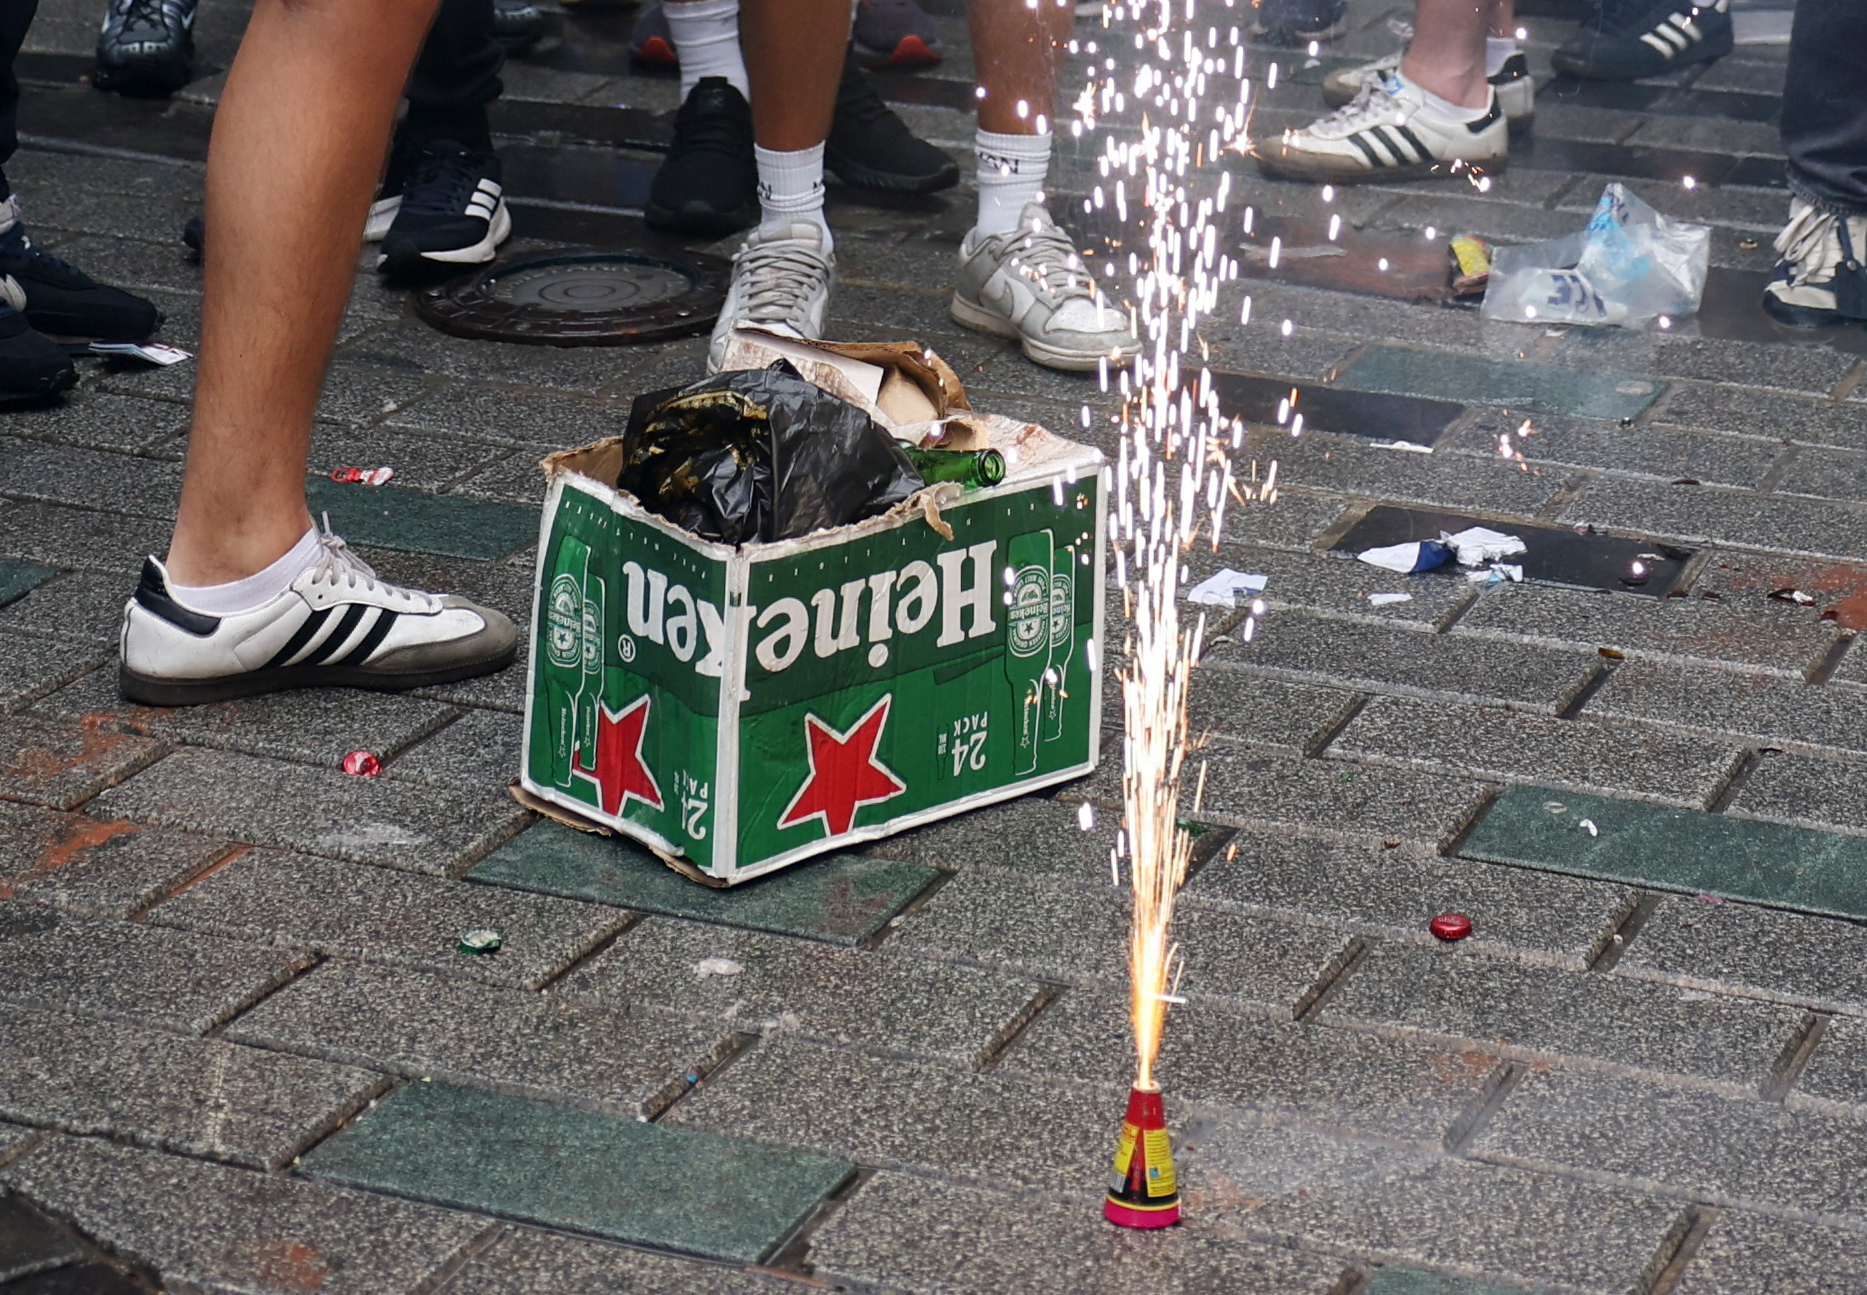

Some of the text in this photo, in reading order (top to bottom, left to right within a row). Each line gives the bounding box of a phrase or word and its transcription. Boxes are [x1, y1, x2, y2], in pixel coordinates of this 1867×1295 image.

[621, 539, 998, 703] Heineken
[1010, 602, 1050, 621] Heineken
[953, 710, 988, 737] PACK
[951, 730, 988, 777] 24
